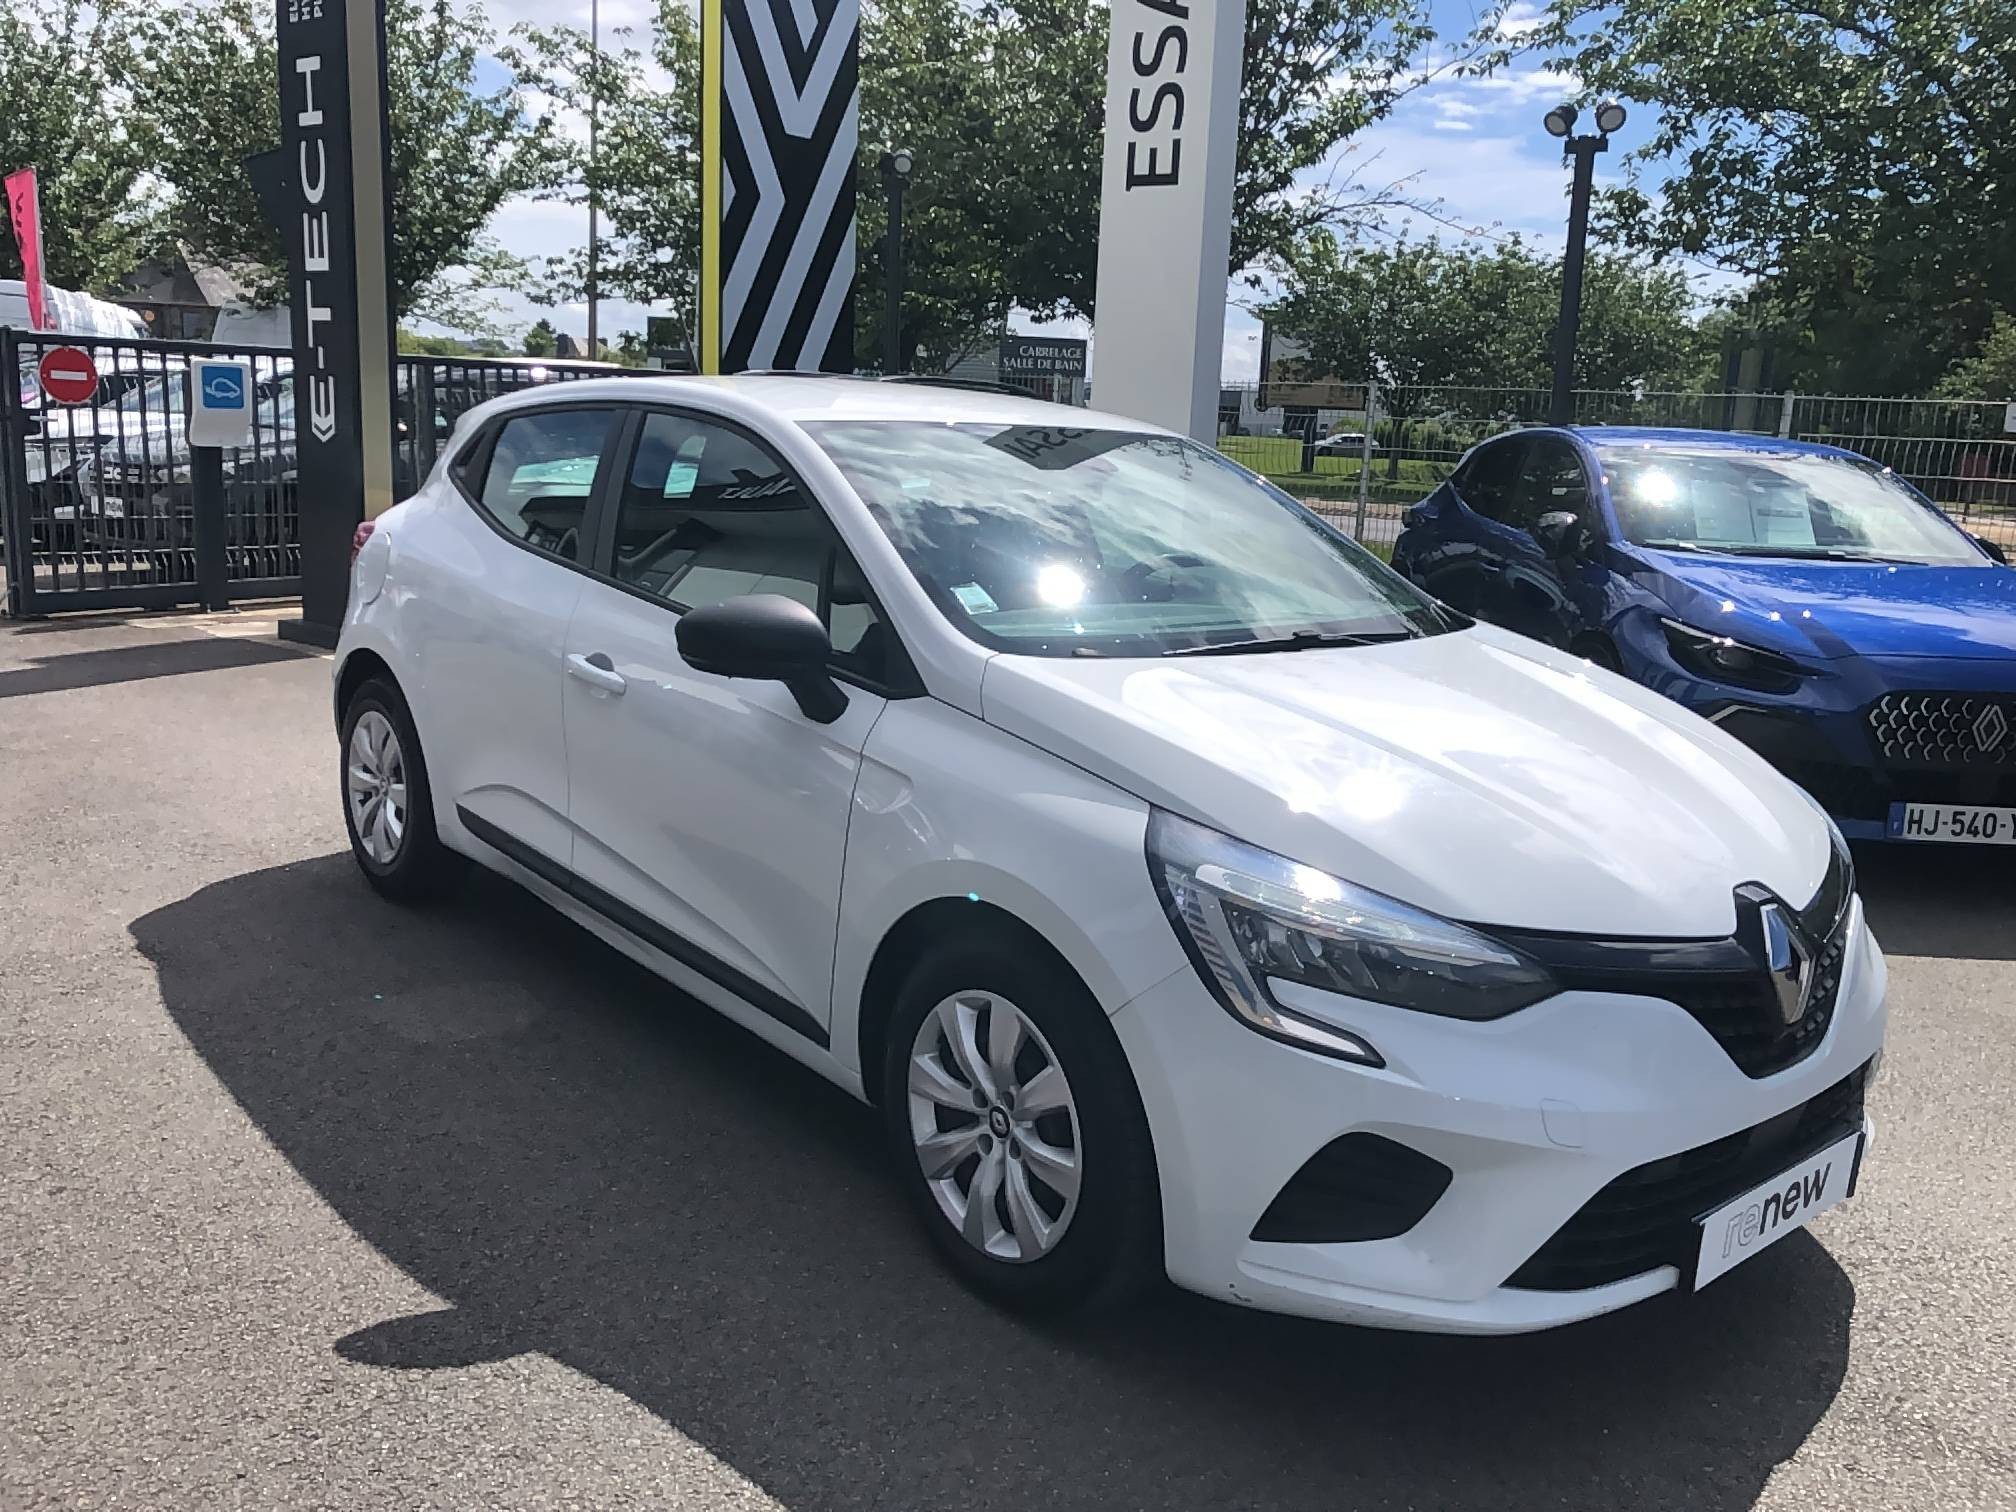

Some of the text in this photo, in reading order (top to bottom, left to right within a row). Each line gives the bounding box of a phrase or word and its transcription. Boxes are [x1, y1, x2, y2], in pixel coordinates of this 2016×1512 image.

[296, 55, 336, 442] E-TECH
[1003, 356, 1083, 371] SALLE DE BAIN
[1019, 345, 1082, 359] CARRELAGE
[1907, 808, 2016, 839] HJ-540-
[1722, 1161, 1832, 1259] renew
